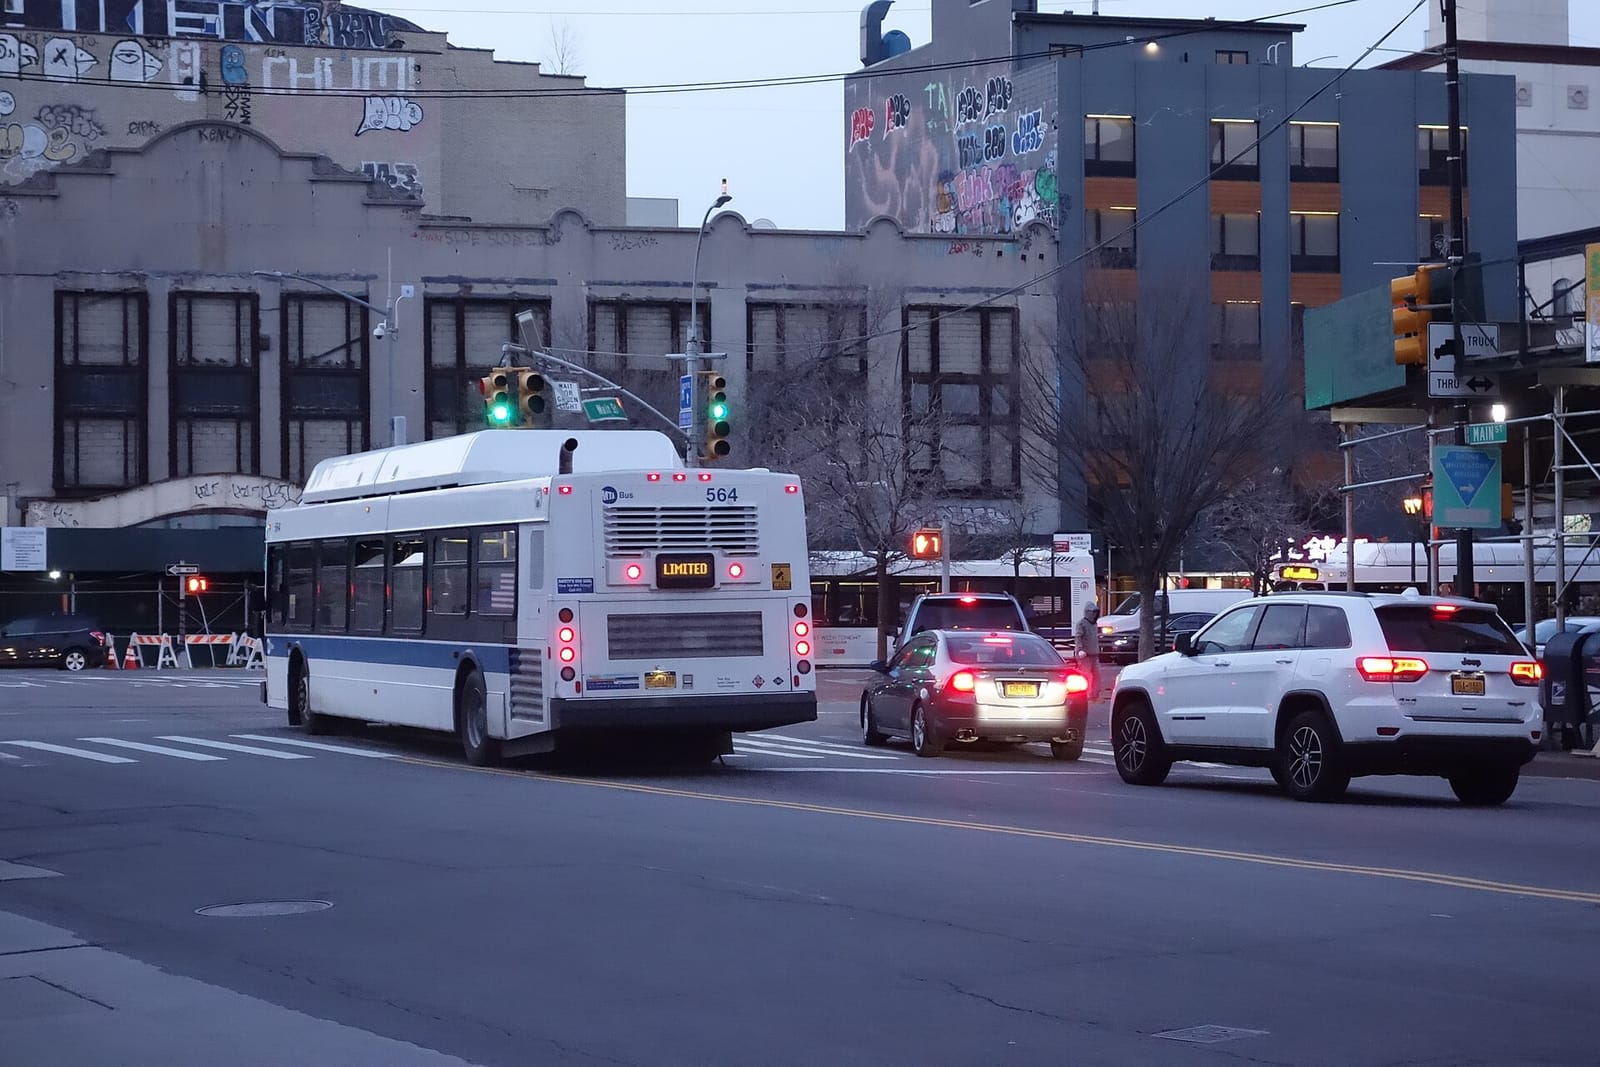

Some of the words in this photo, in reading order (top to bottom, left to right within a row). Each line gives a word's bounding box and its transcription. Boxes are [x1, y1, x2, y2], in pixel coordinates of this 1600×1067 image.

[1467, 336, 1495, 347] TRUCK
[1437, 378, 1460, 389] THRU
[1472, 425, 1495, 442] MAIN
[1495, 424, 1504, 433] ST
[619, 491, 634, 499] Bus
[706, 487, 739, 502] 564
[663, 563, 708, 575] LIMITED
